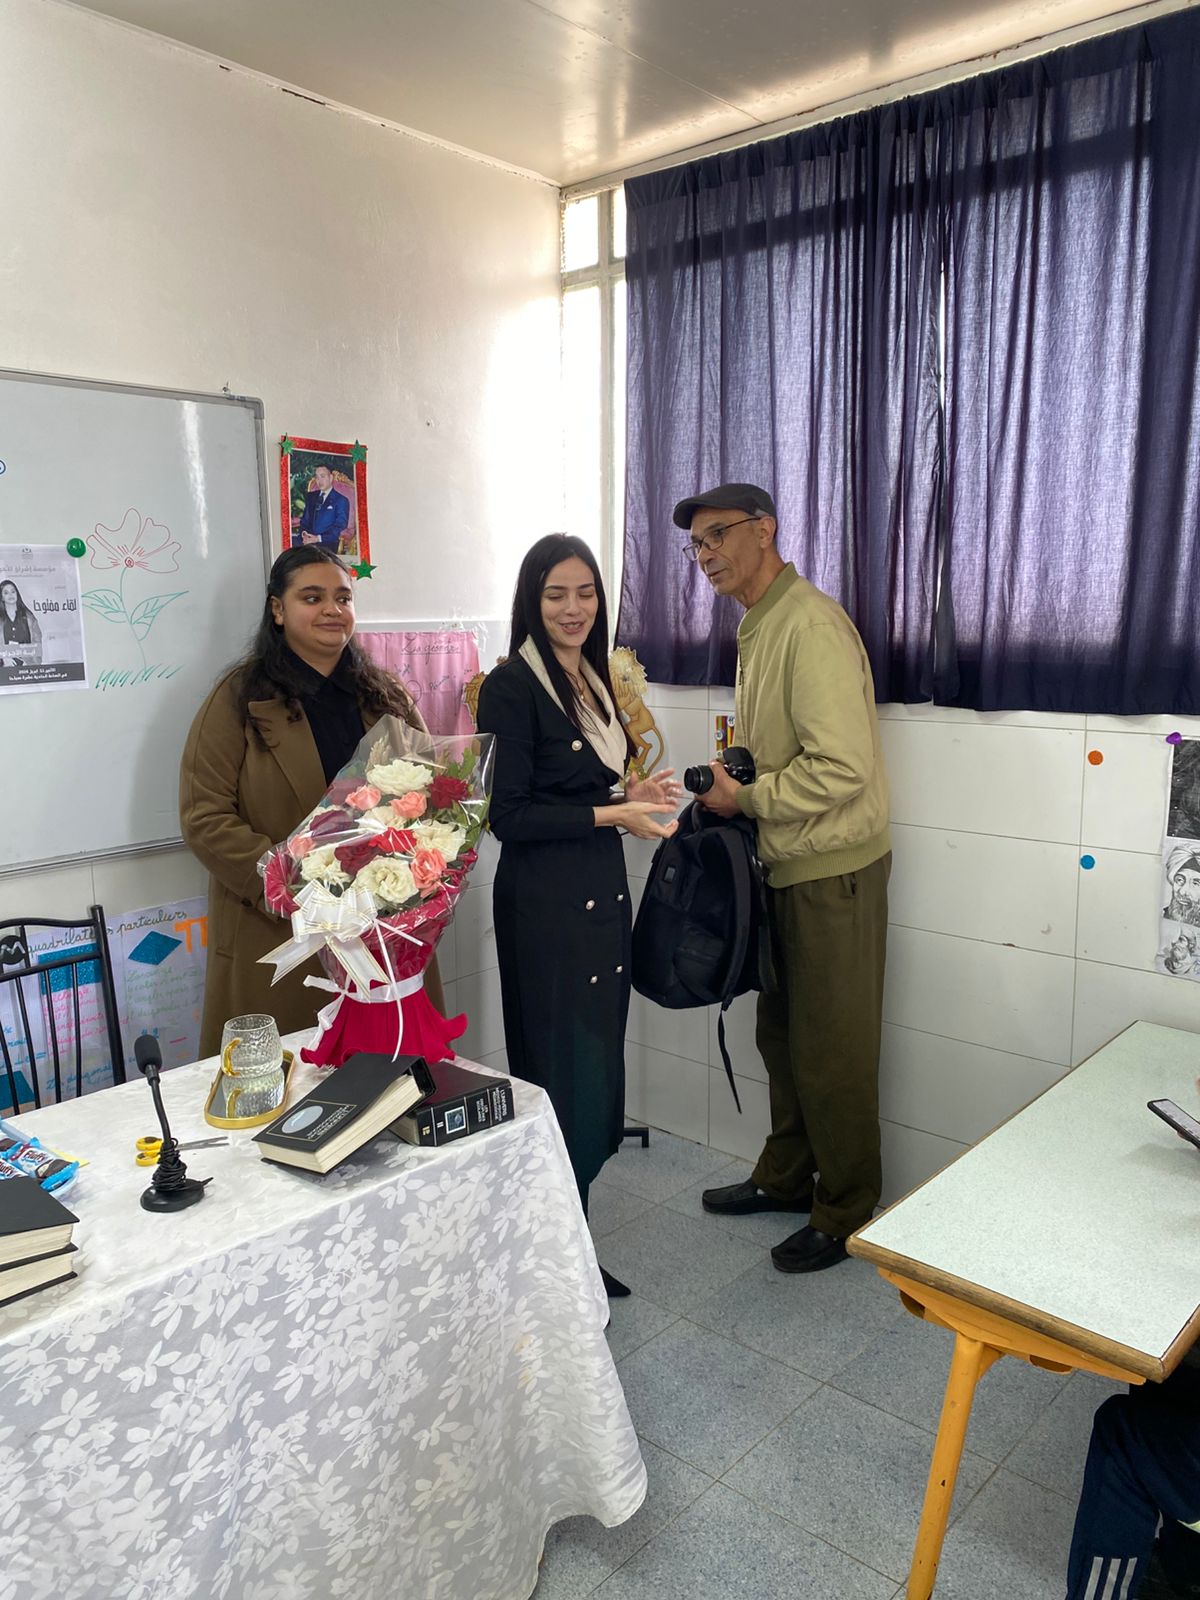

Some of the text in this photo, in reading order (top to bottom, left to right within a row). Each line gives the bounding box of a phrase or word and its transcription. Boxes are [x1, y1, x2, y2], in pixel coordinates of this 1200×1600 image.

[62, 597, 77, 612] لقاء
[117, 909, 187, 937] particuliers
[23, 1150, 47, 1163] Fluffy
